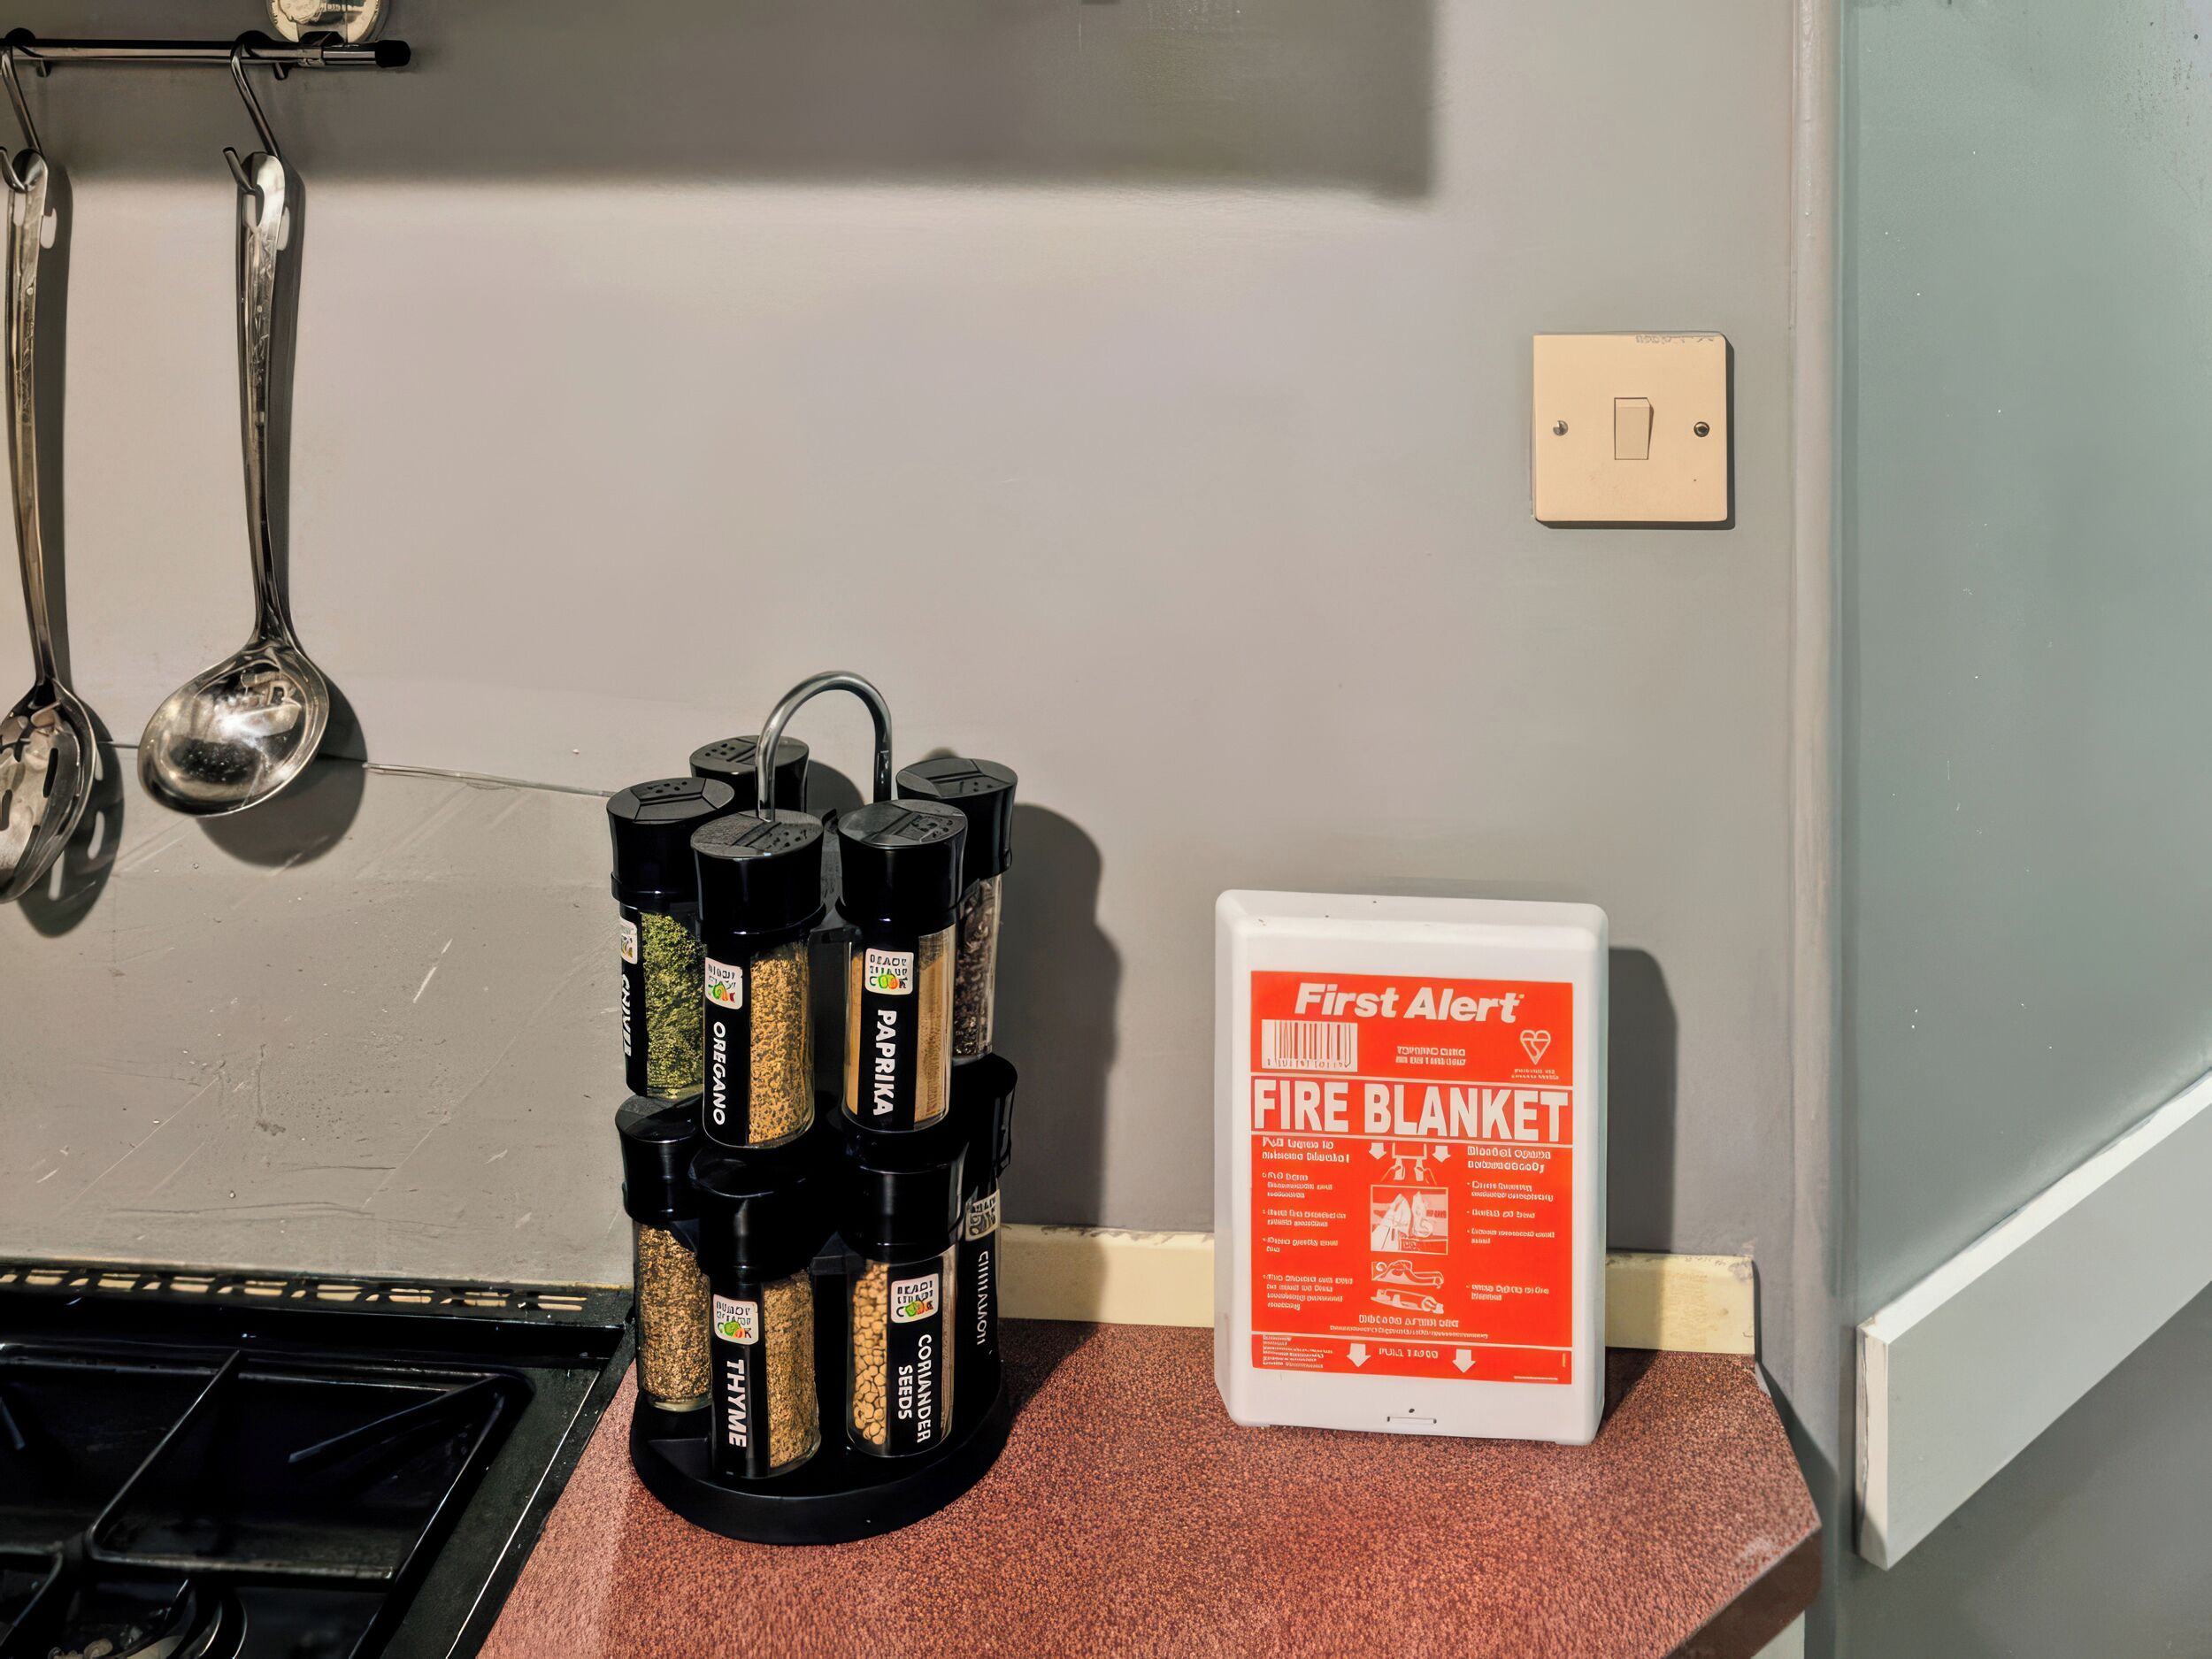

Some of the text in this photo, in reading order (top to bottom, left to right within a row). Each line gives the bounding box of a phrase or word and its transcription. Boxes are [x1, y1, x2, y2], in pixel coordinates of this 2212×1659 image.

[1294, 982, 1520, 1024] First Alert
[712, 1021, 726, 1126] OREGANO
[872, 1009, 897, 1116] PAPRIKA
[1254, 1079, 1569, 1143] FIRE BLANKET
[727, 1359, 747, 1448] THYME
[897, 1364, 913, 1420] SEEDS
[917, 1333, 933, 1443] CORIANDER
